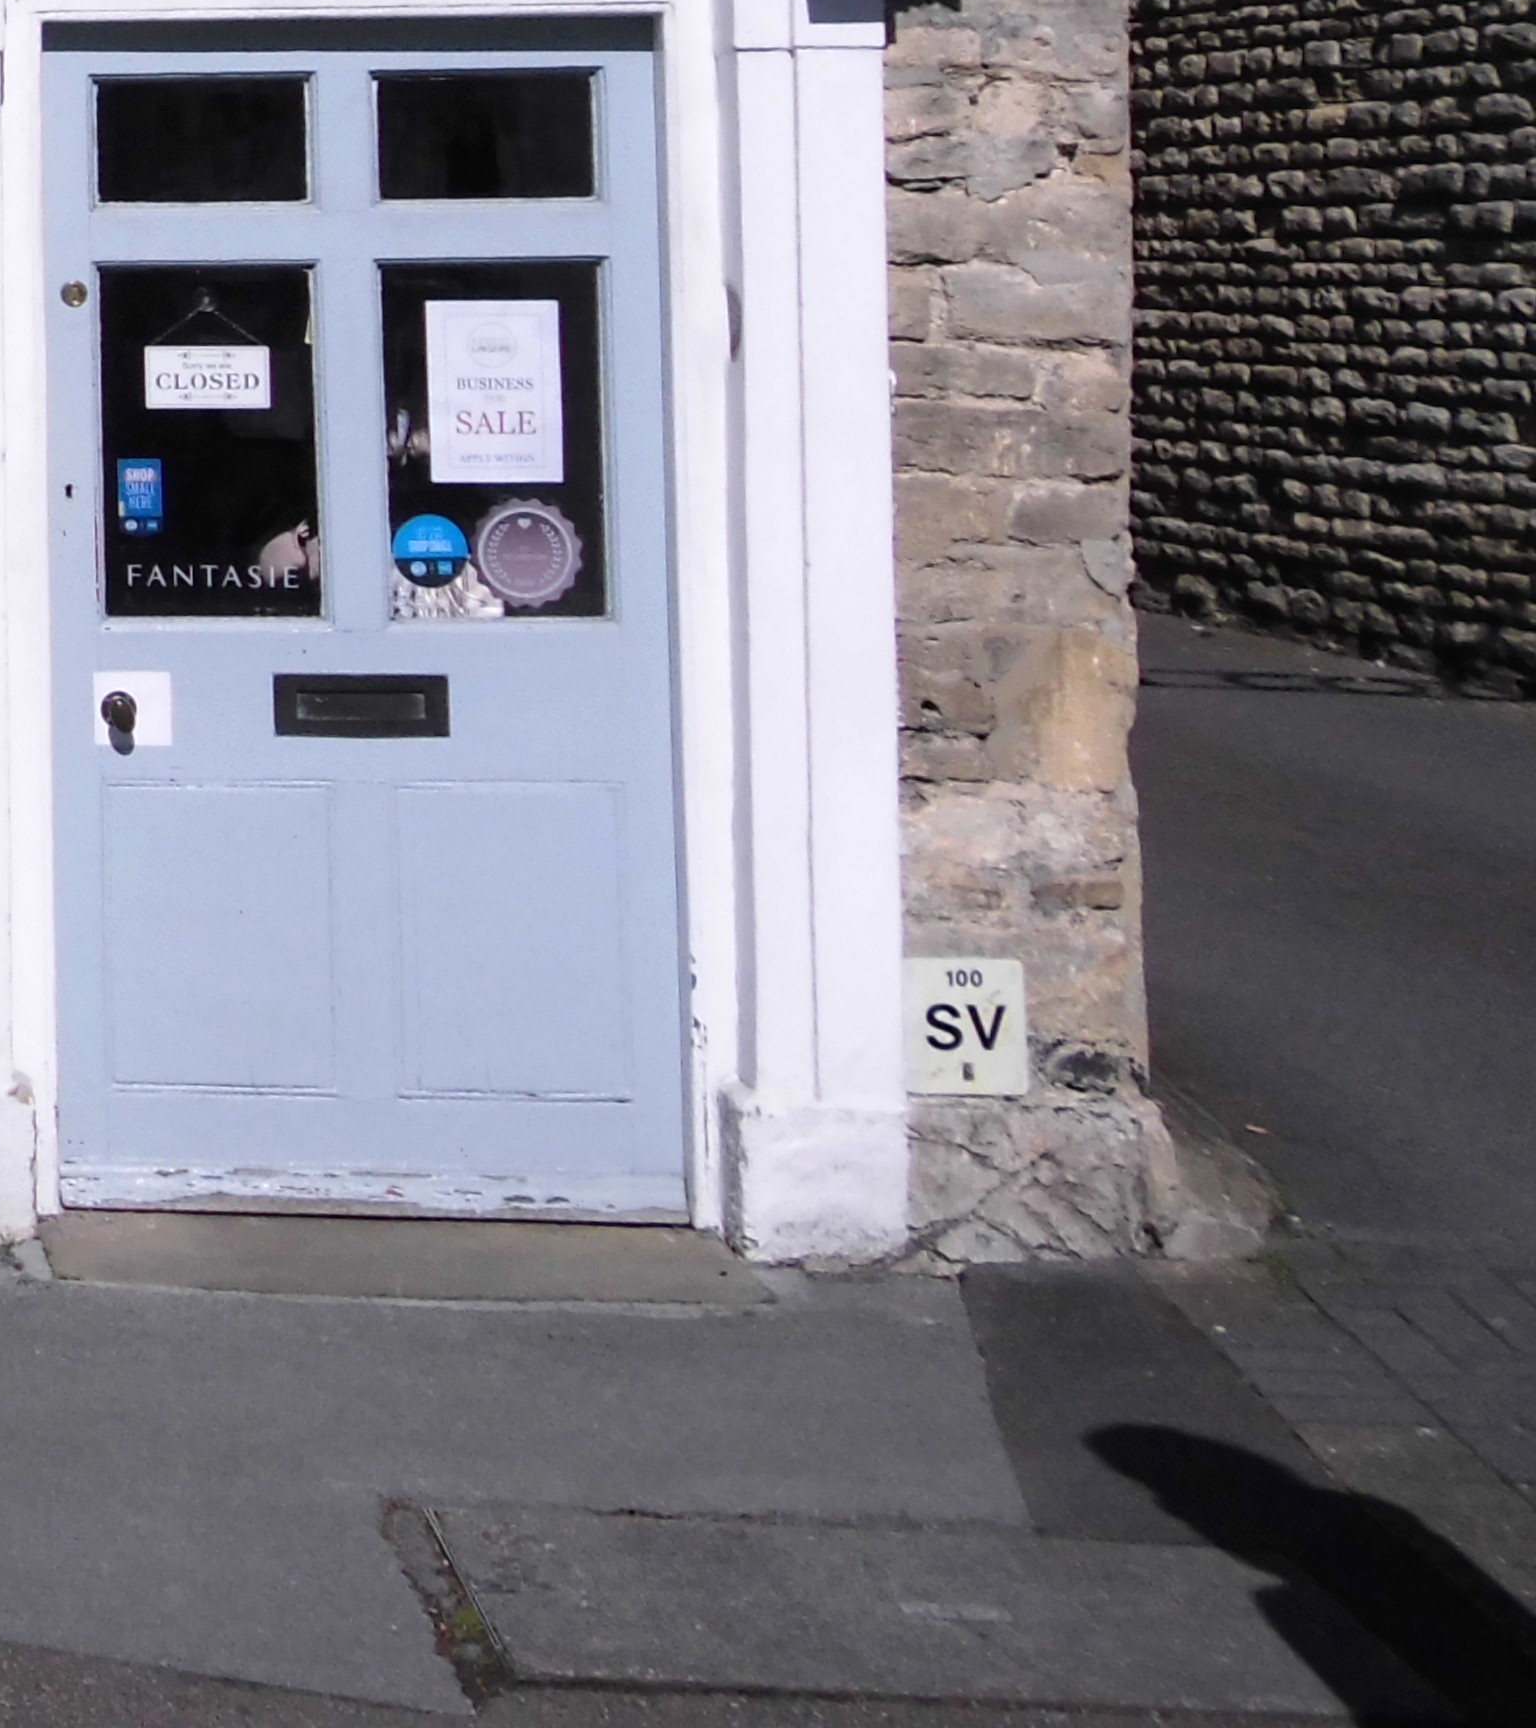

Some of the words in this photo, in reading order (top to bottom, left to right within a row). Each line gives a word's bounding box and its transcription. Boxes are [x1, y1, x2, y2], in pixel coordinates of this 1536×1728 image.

[155, 373, 260, 390] CLOSED
[456, 378, 534, 391] BUSINESS
[455, 411, 537, 435] SALE
[125, 468, 156, 481] SHOP
[126, 483, 156, 496] SMALL
[128, 496, 153, 509] HERE
[126, 564, 301, 590] FANTASIE
[945, 969, 984, 988] 100
[925, 1003, 1006, 1051] SV
